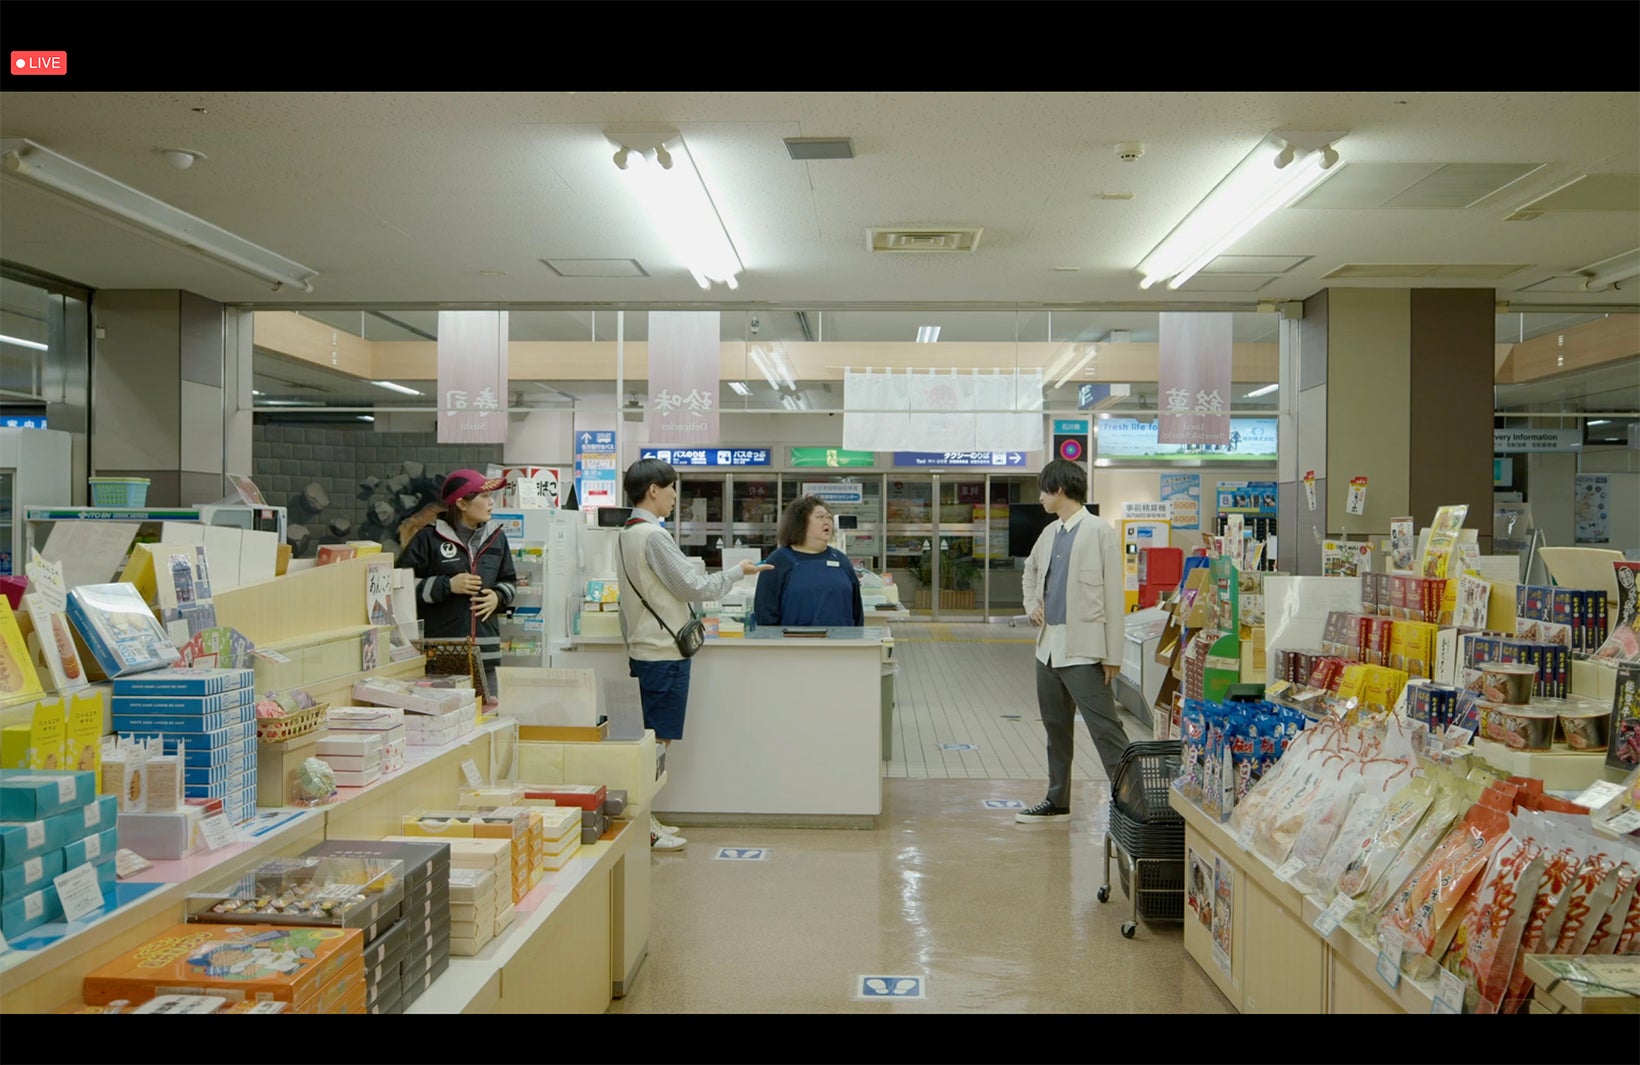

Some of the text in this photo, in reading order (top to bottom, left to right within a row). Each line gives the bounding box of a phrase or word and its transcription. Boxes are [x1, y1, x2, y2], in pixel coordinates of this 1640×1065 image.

[1103, 422, 1158, 431] Fresh life fo
[673, 450, 706, 458] バスのりば
[943, 451, 990, 460] タクシーのりば
